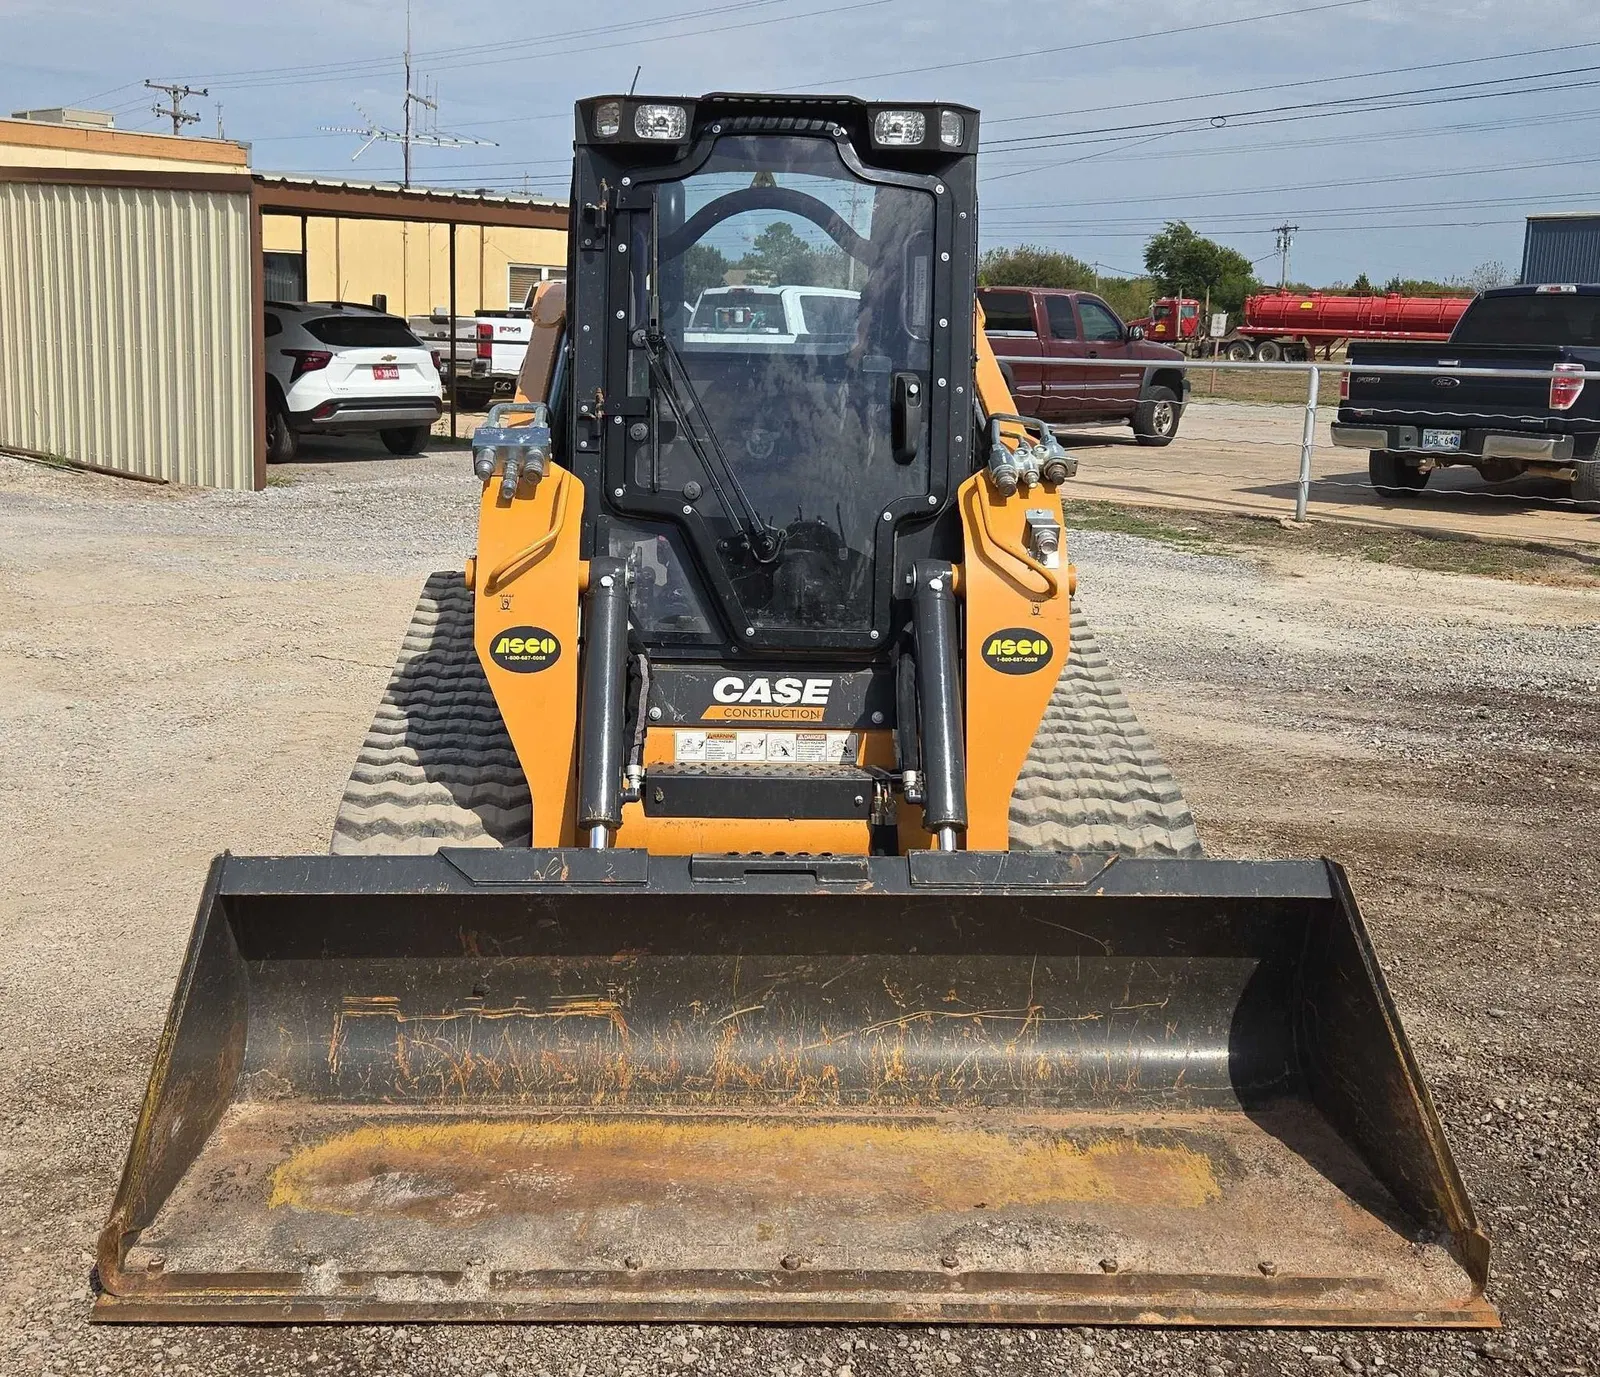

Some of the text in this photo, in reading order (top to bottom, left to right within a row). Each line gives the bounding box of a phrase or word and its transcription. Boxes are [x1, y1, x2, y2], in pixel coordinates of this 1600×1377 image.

[494, 637, 557, 654] ASCO
[986, 639, 1048, 656] ASCO
[712, 676, 833, 705] CASE
[723, 708, 821, 720] CONSTRUCTION
